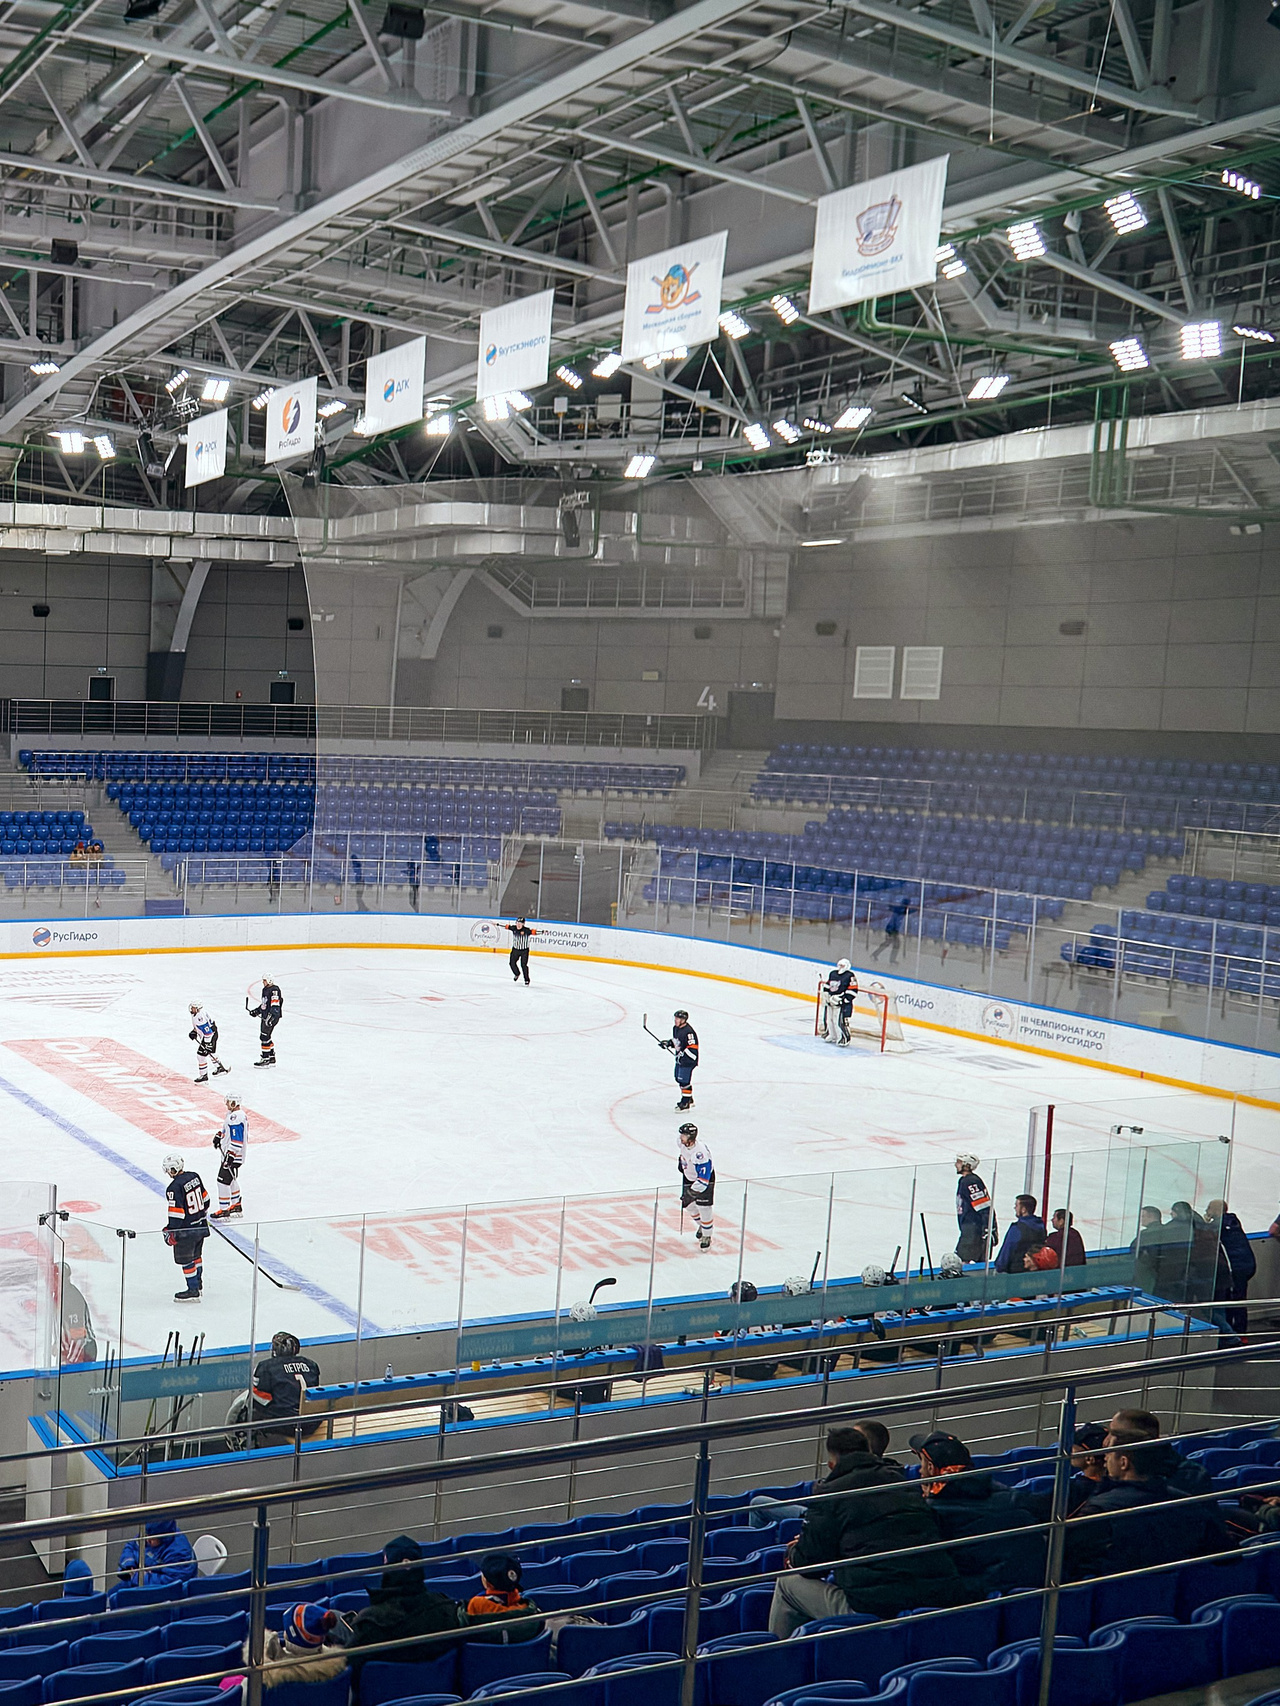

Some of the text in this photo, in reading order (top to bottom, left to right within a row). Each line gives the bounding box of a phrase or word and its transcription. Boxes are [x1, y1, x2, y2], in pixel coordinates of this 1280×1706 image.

[498, 335, 546, 357] Якутскэнерго
[696, 686, 718, 711] 4
[52, 932, 98, 942] РусГидро
[548, 938, 588, 948] РУСГИДРО
[574, 932, 589, 940] КХЛ
[894, 994, 934, 1010] усГидро
[1020, 1015, 1106, 1040] III ЧЕМПИОНАТ КХЛ
[1019, 1026, 1103, 1051] ГРУППЫ РУСГИДРО
[186, 1186, 204, 1214] 90
[68, 1313, 78, 1324] 13
[283, 1362, 310, 1374] ПЕТРОВ
[294, 1374, 307, 1391] 1
